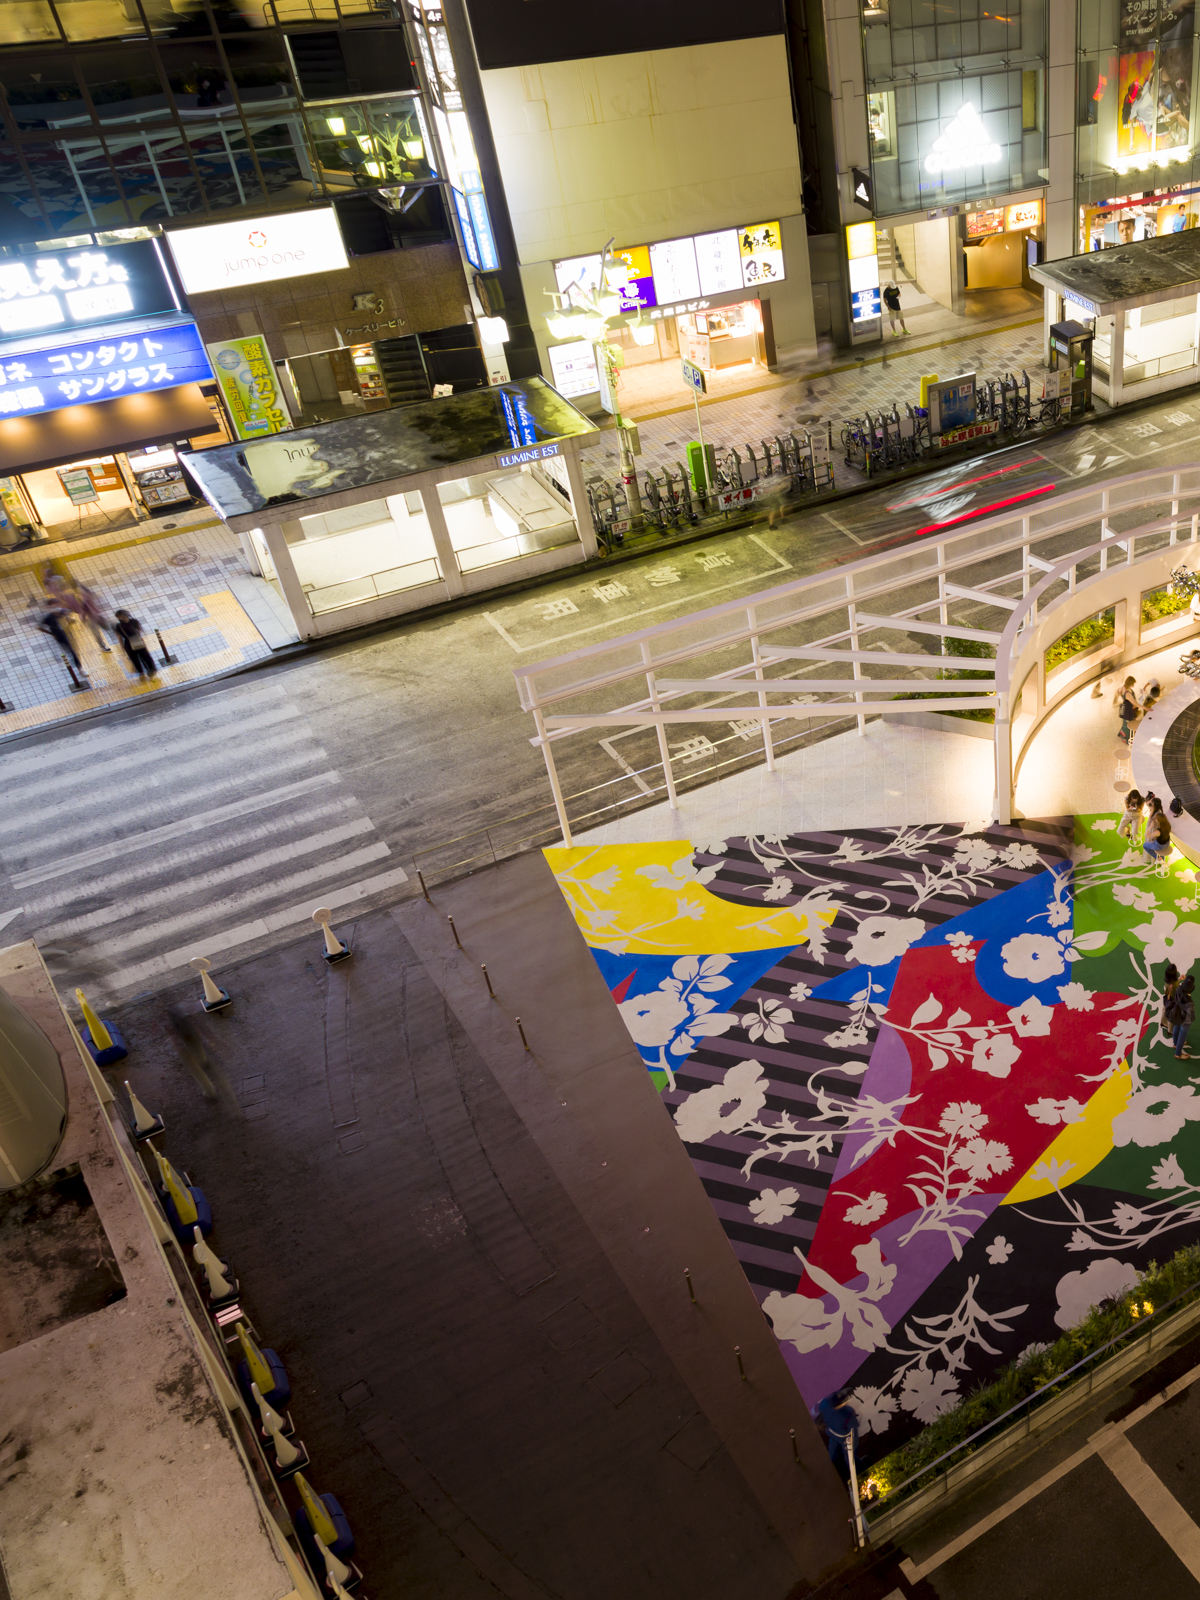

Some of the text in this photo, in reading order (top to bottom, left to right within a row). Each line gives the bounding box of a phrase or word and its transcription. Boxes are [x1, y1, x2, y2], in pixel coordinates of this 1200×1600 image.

[224, 249, 306, 276] jump one
[345, 318, 405, 336] ケースリービル
[48, 337, 163, 374] コンタクト
[57, 363, 175, 400] サングラス
[500, 444, 559, 467] LUMINE EST
